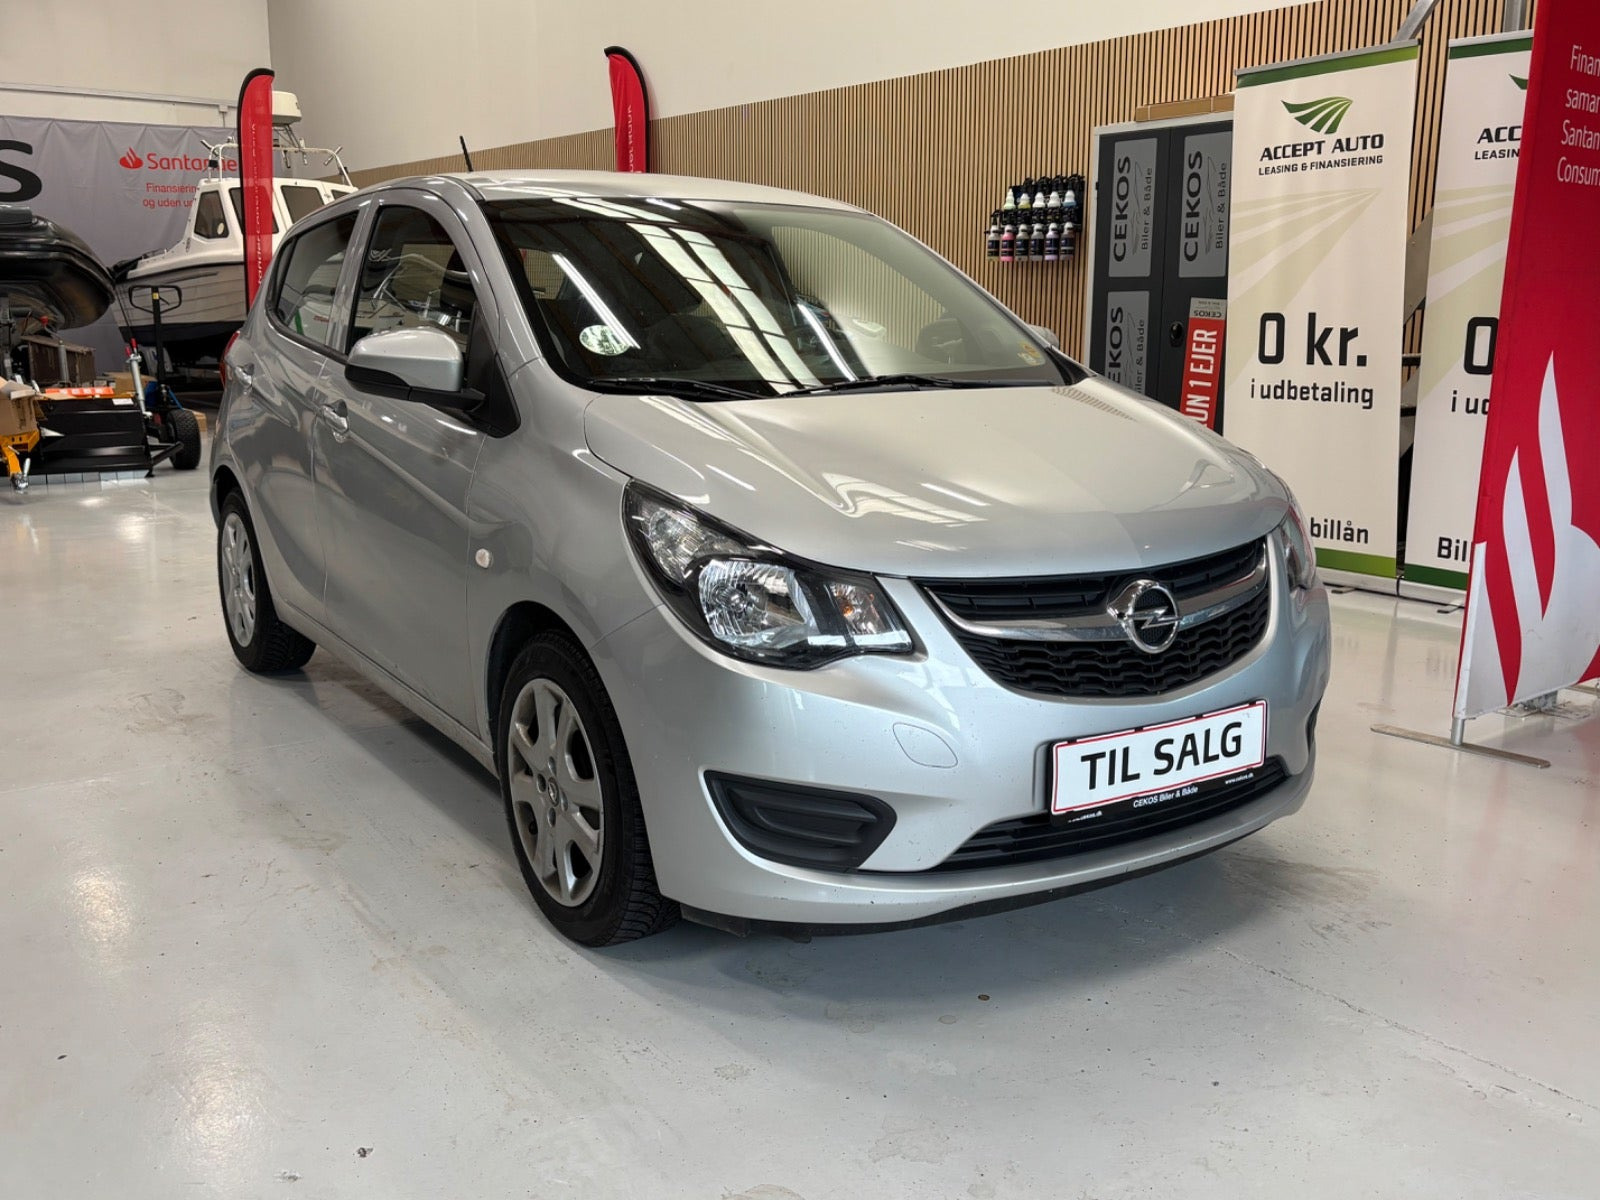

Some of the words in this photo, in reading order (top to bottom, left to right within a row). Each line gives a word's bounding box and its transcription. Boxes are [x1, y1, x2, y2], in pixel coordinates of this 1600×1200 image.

[1570, 44, 1600, 77] Finan
[1259, 140, 1326, 162] ACCEPT
[1331, 134, 1384, 154] AUTO
[1477, 126, 1521, 144] ACC
[1561, 119, 1600, 150] Santan
[1217, 163, 1227, 197] Både
[1258, 163, 1298, 176] LEASING
[1301, 163, 1308, 171] &
[1310, 155, 1383, 170] FINANSIERING
[1557, 156, 1600, 187] Consum
[1144, 167, 1152, 201] Både
[143, 198, 156, 209] og
[158, 198, 181, 207] uden
[1113, 156, 1131, 262] CEKOS
[1184, 151, 1203, 262] CEKOS
[1217, 204, 1225, 213] &
[1141, 221, 1149, 250] Biler
[1216, 217, 1224, 249] Biler
[1190, 329, 1218, 374] EJER
[1258, 312, 1286, 365] 0
[1306, 312, 1368, 367] kr.
[1463, 316, 1499, 375] 0
[1136, 358, 1143, 367] &
[1188, 380, 1212, 388] 1
[1250, 378, 1256, 399] i
[1260, 379, 1374, 410] udbetaling
[1186, 394, 1210, 427] UN
[1451, 390, 1458, 412] i
[1310, 516, 1369, 544] billån
[1437, 536, 1468, 562] Bil
[1080, 746, 1141, 790] TIL
[1153, 721, 1243, 776] SALG
[1133, 794, 1158, 808] CEKOS
[1159, 791, 1174, 802] Biler
[1175, 789, 1181, 798] &
[1181, 785, 1199, 796] Både
